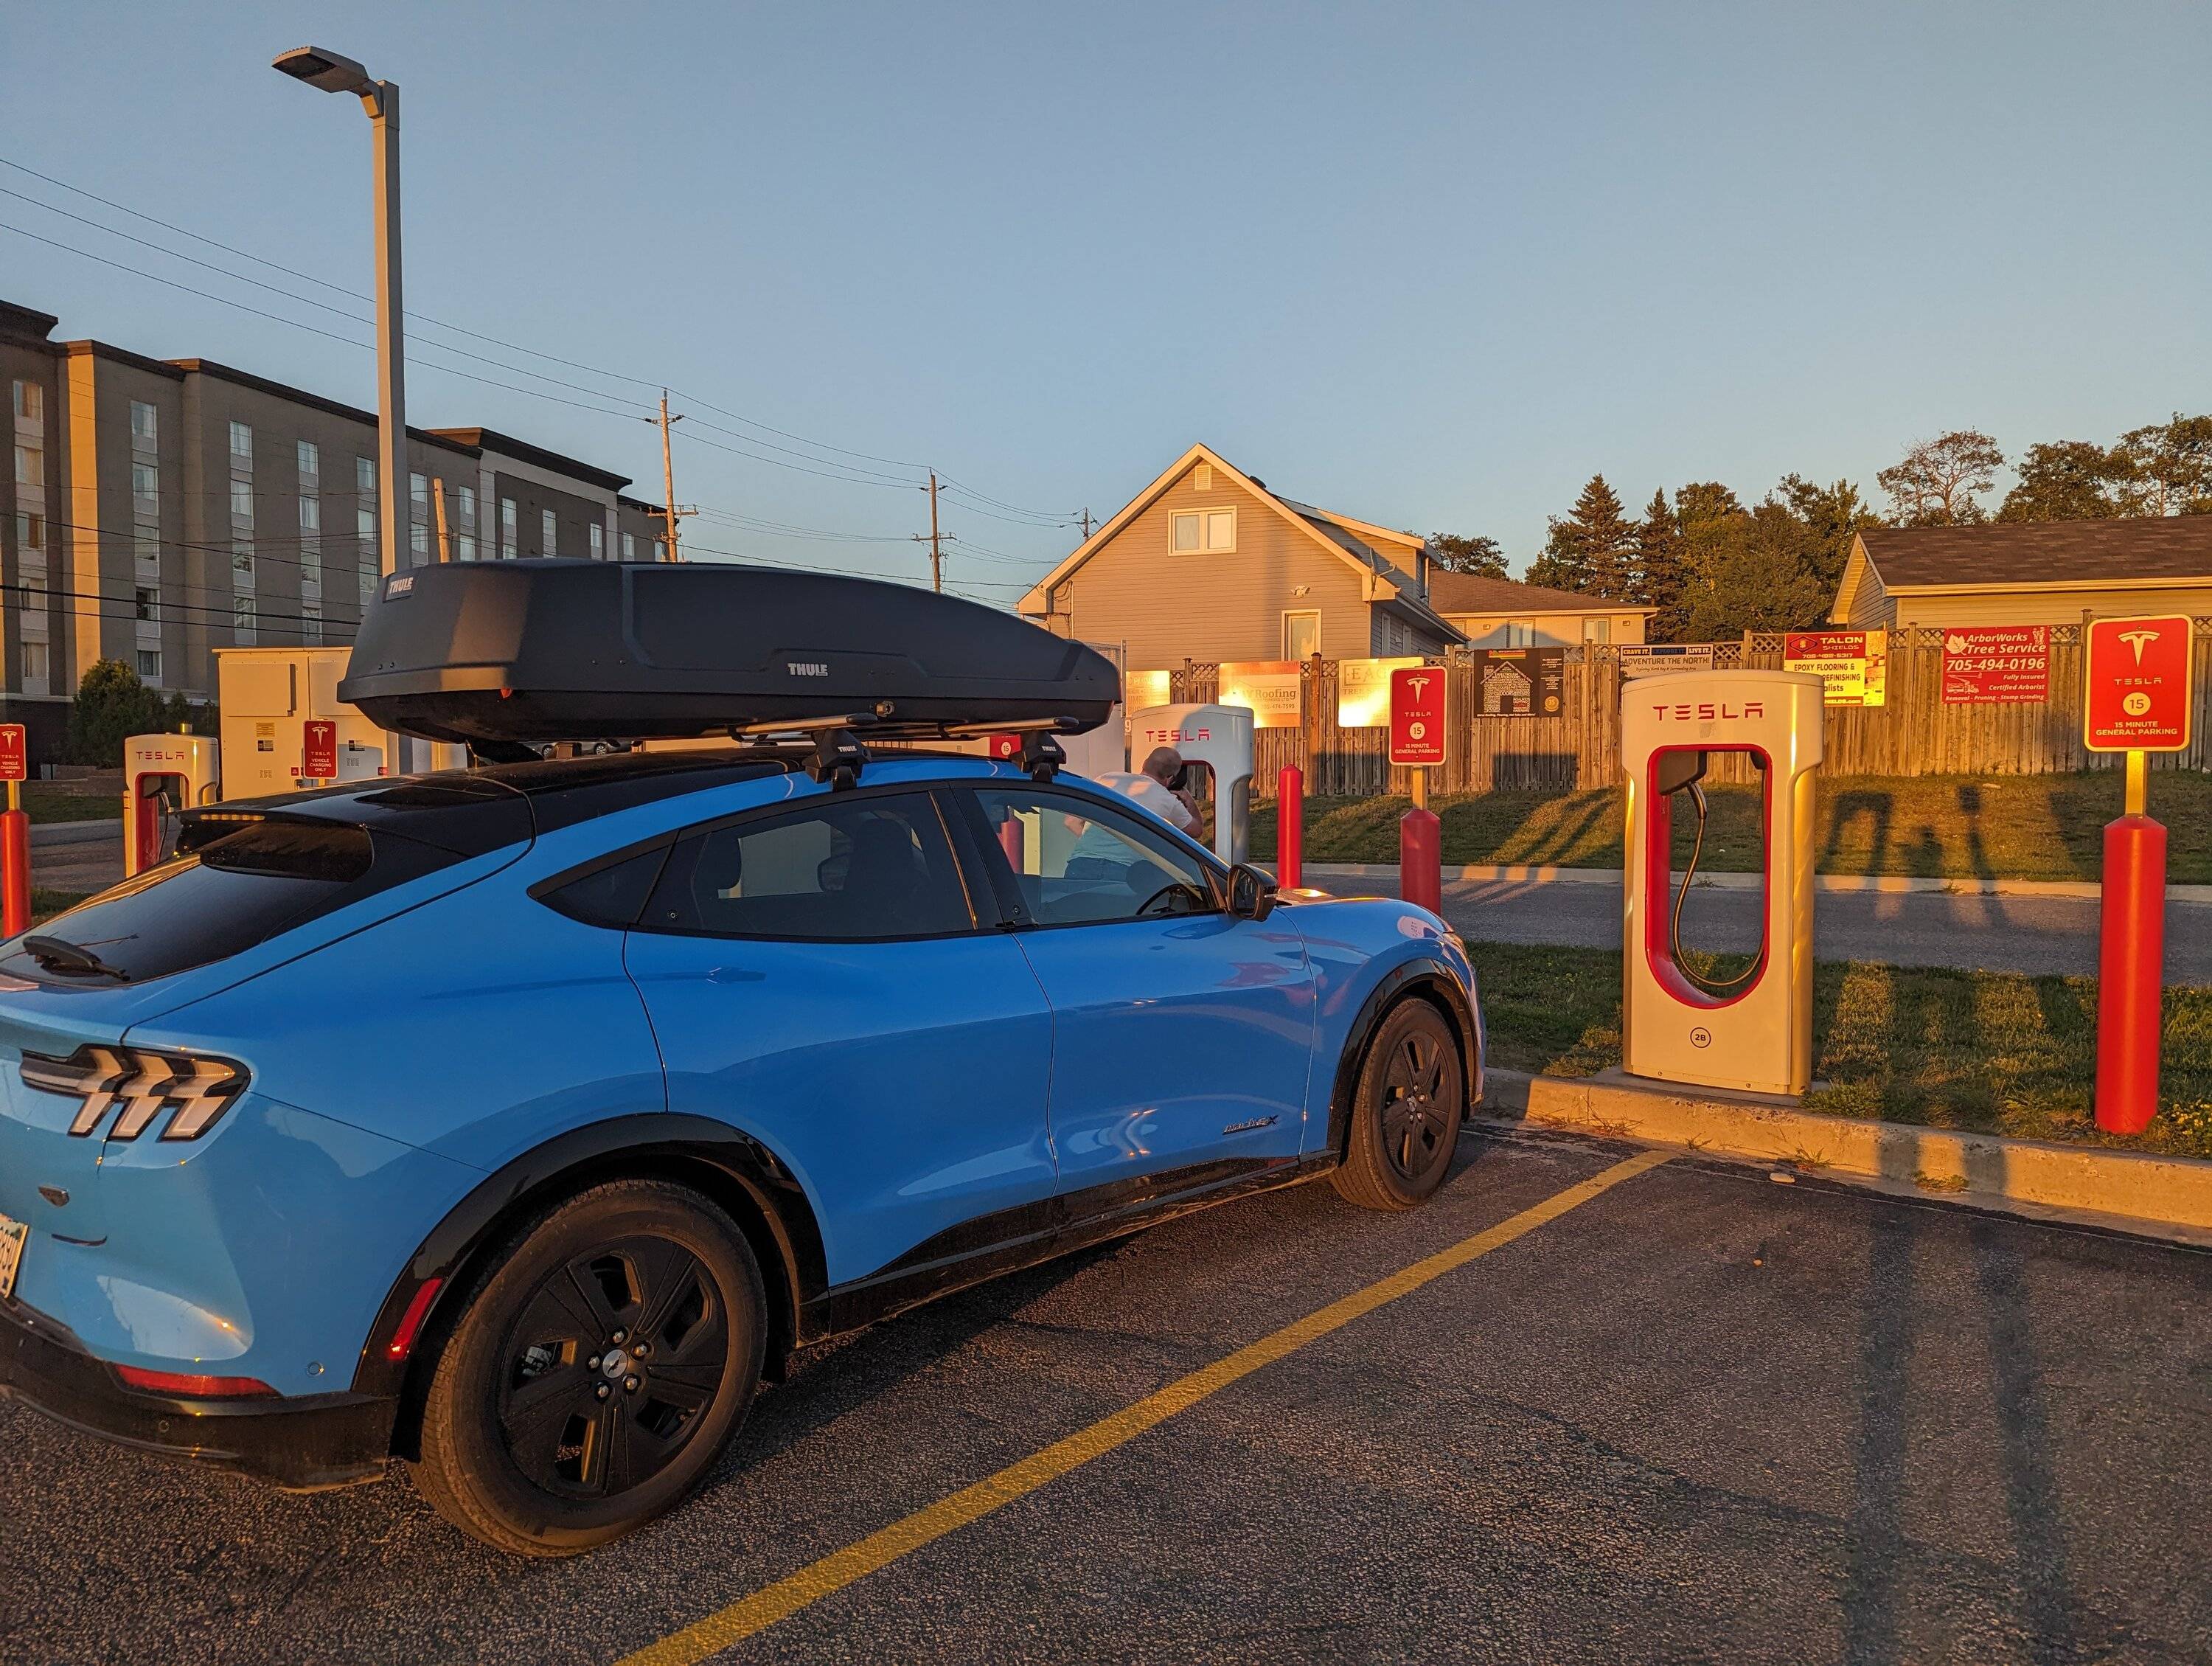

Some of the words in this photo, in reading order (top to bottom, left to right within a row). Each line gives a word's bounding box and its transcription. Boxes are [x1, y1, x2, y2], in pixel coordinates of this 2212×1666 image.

[389, 577, 414, 594] THULE
[1966, 632, 2028, 643] ArborWorks
[1967, 644, 1996, 654] Tree
[1999, 642, 2047, 653] Service
[787, 662, 829, 677] THULE
[1816, 663, 1848, 671] FLOORING
[1946, 657, 2046, 671] 705-494-0196
[2114, 677, 2162, 685] TESLA
[1823, 684, 1844, 692] alists
[1254, 688, 1297, 700] Roofing
[2129, 699, 2144, 709] 15
[1652, 702, 1764, 721] TESLA
[1145, 729, 1210, 743] TESLA
[1413, 726, 1422, 735] 15
[136, 751, 185, 760] TESLA
